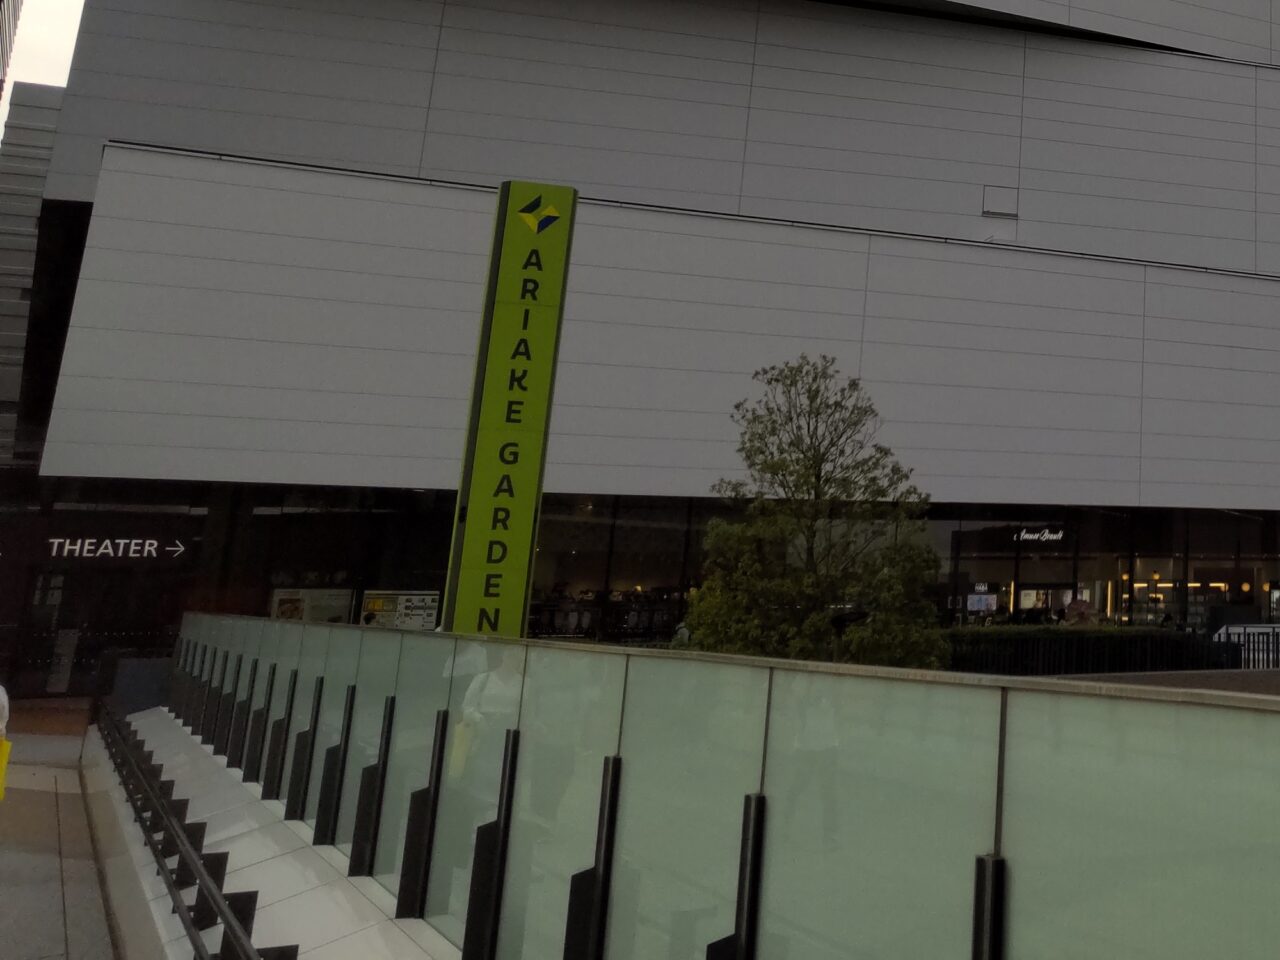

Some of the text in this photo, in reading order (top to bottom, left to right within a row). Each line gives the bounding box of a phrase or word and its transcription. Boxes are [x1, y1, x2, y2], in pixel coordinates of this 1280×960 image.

[477, 248, 543, 633] ARIAKE GARDEN
[48, 538, 158, 557] THEATER
